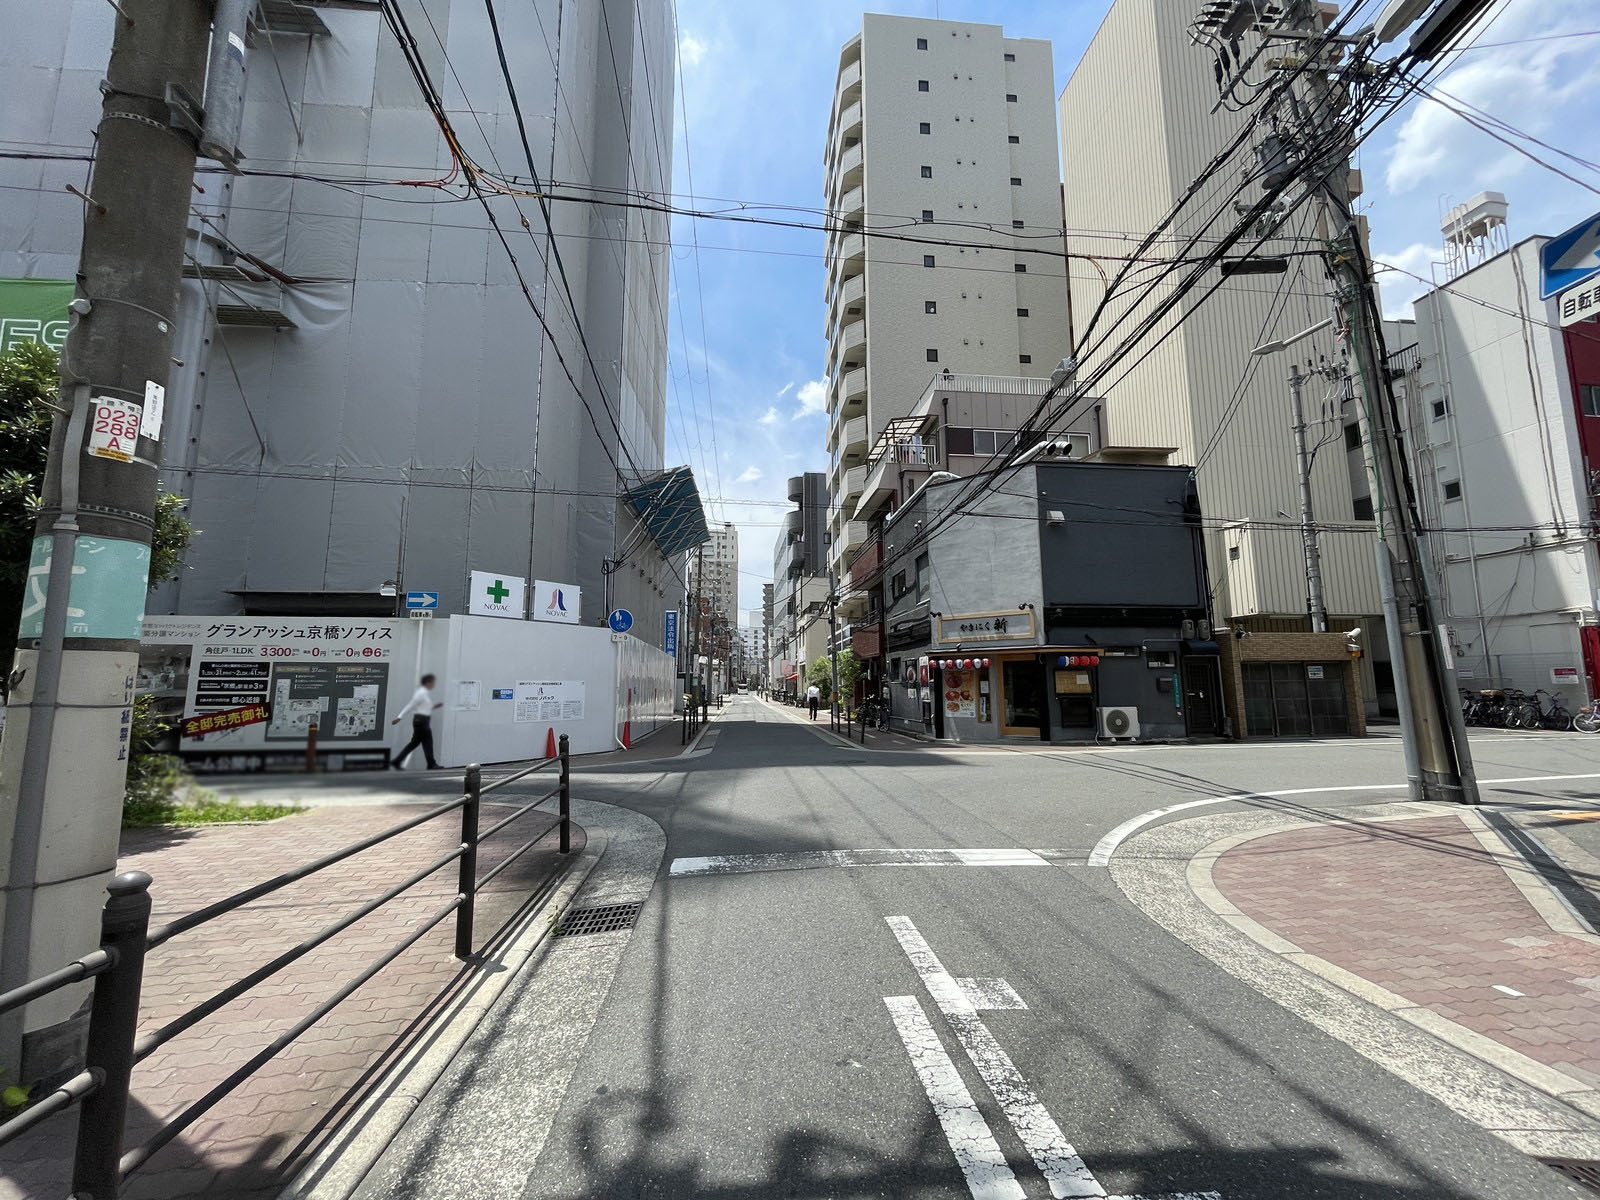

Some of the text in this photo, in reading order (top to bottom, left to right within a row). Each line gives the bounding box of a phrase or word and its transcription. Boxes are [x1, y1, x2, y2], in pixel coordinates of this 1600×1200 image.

[97, 406, 139, 427] 023
[95, 420, 137, 440] 288
[107, 437, 120, 450] A
[484, 603, 511, 612] NOVAC
[545, 609, 569, 618] NOVAC
[207, 624, 393, 640] グランアッシュ京橋ソフィス
[260, 647, 292, 657] 3,300
[186, 706, 269, 734] 全邸完売御礼
